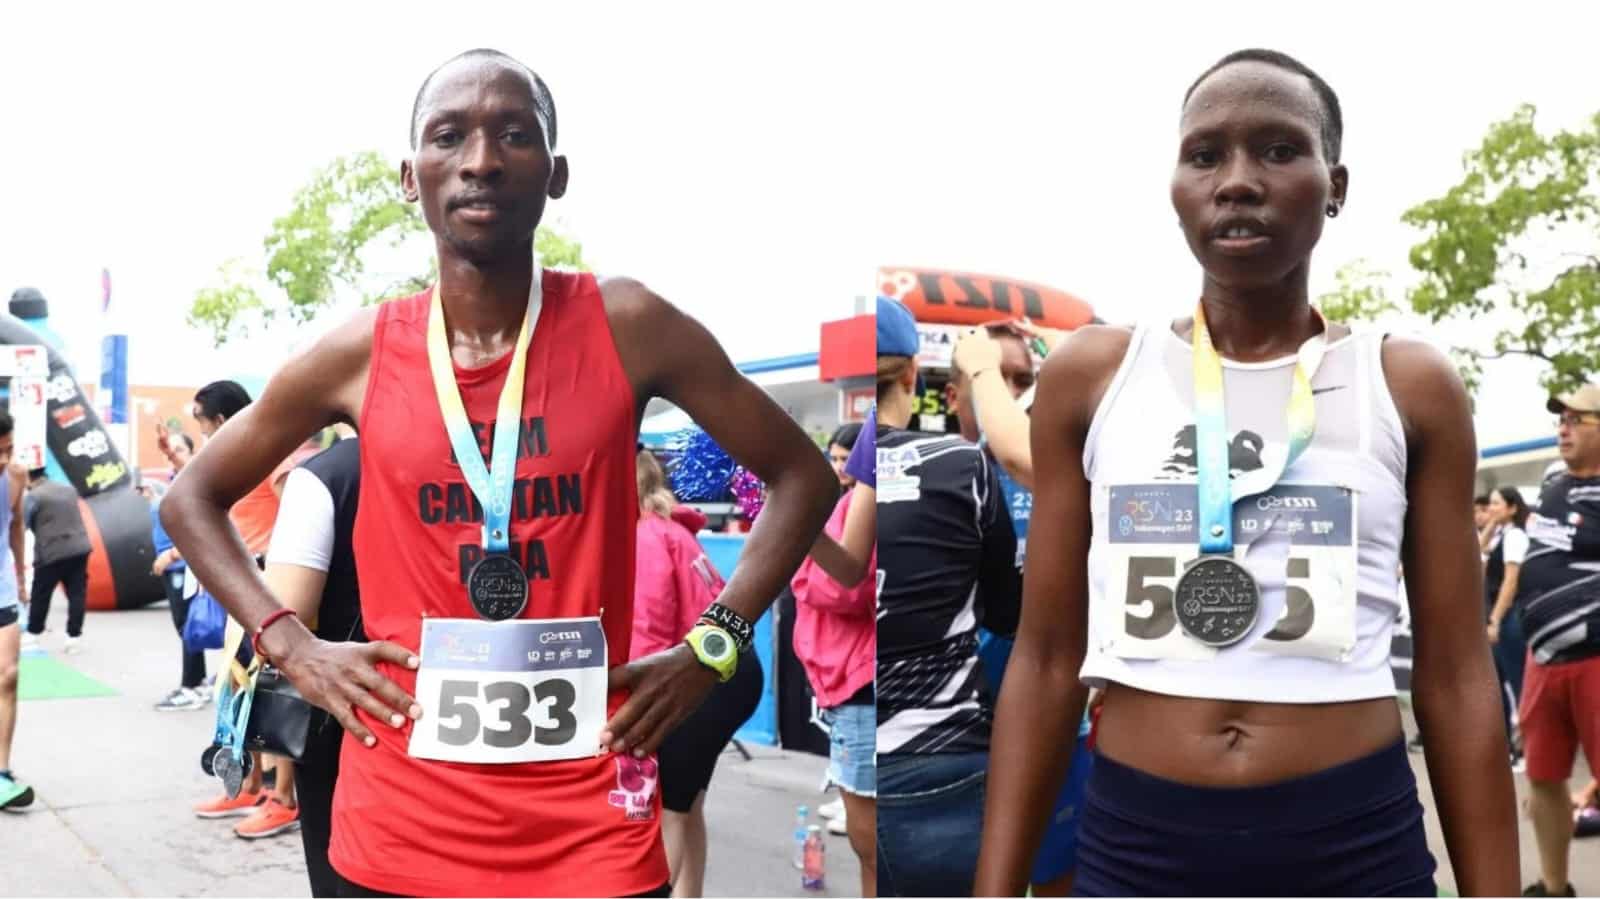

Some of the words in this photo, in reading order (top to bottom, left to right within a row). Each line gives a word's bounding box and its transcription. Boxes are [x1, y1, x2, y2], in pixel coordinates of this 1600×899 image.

[1284, 496, 1317, 508] rsn
[1175, 509, 1193, 522] 23
[1124, 556, 1315, 641] 55
[1191, 586, 1235, 605] RSN
[558, 630, 582, 641] rsn
[437, 677, 578, 749] 533
